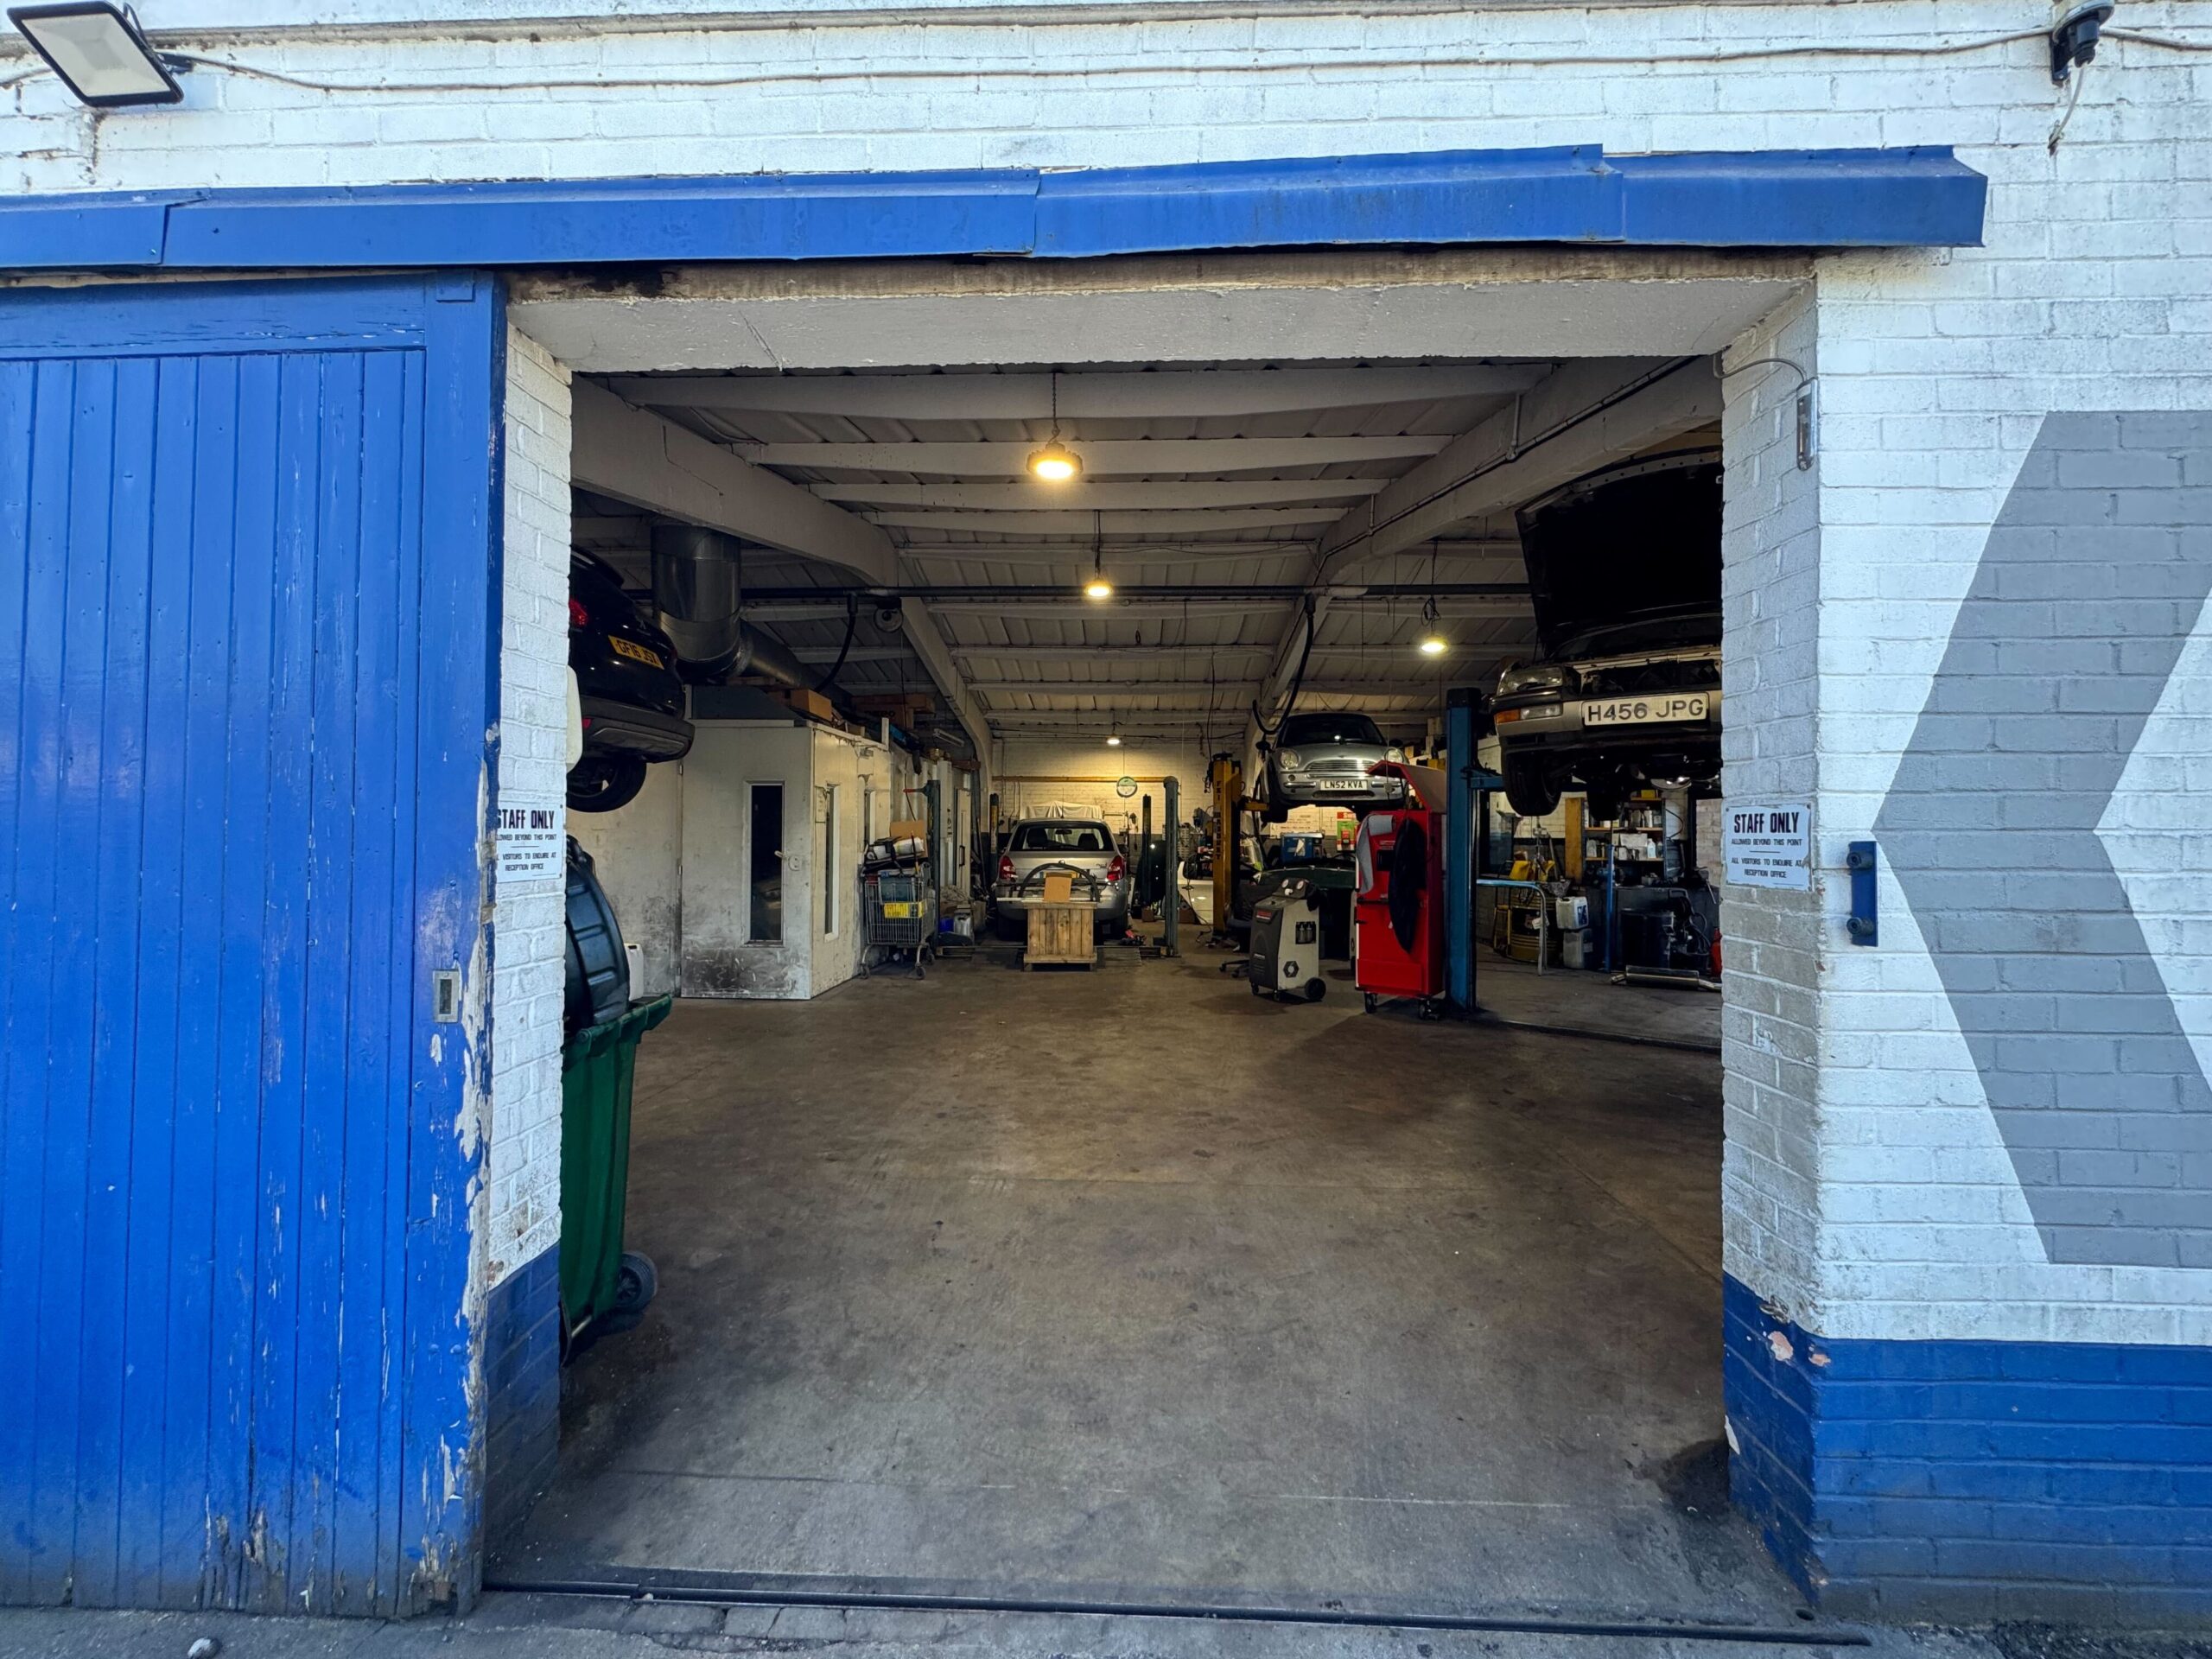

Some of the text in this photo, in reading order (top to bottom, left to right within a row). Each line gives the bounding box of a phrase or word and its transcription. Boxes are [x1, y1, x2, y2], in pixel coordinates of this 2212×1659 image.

[1588, 698, 1704, 721] H456 JPG
[1325, 780, 1363, 789] LN52 KVA
[498, 809, 555, 830] STAFF ONLY
[1734, 812, 1799, 834] STAFF ONLY
[1745, 868, 1768, 877] RECEPTION
